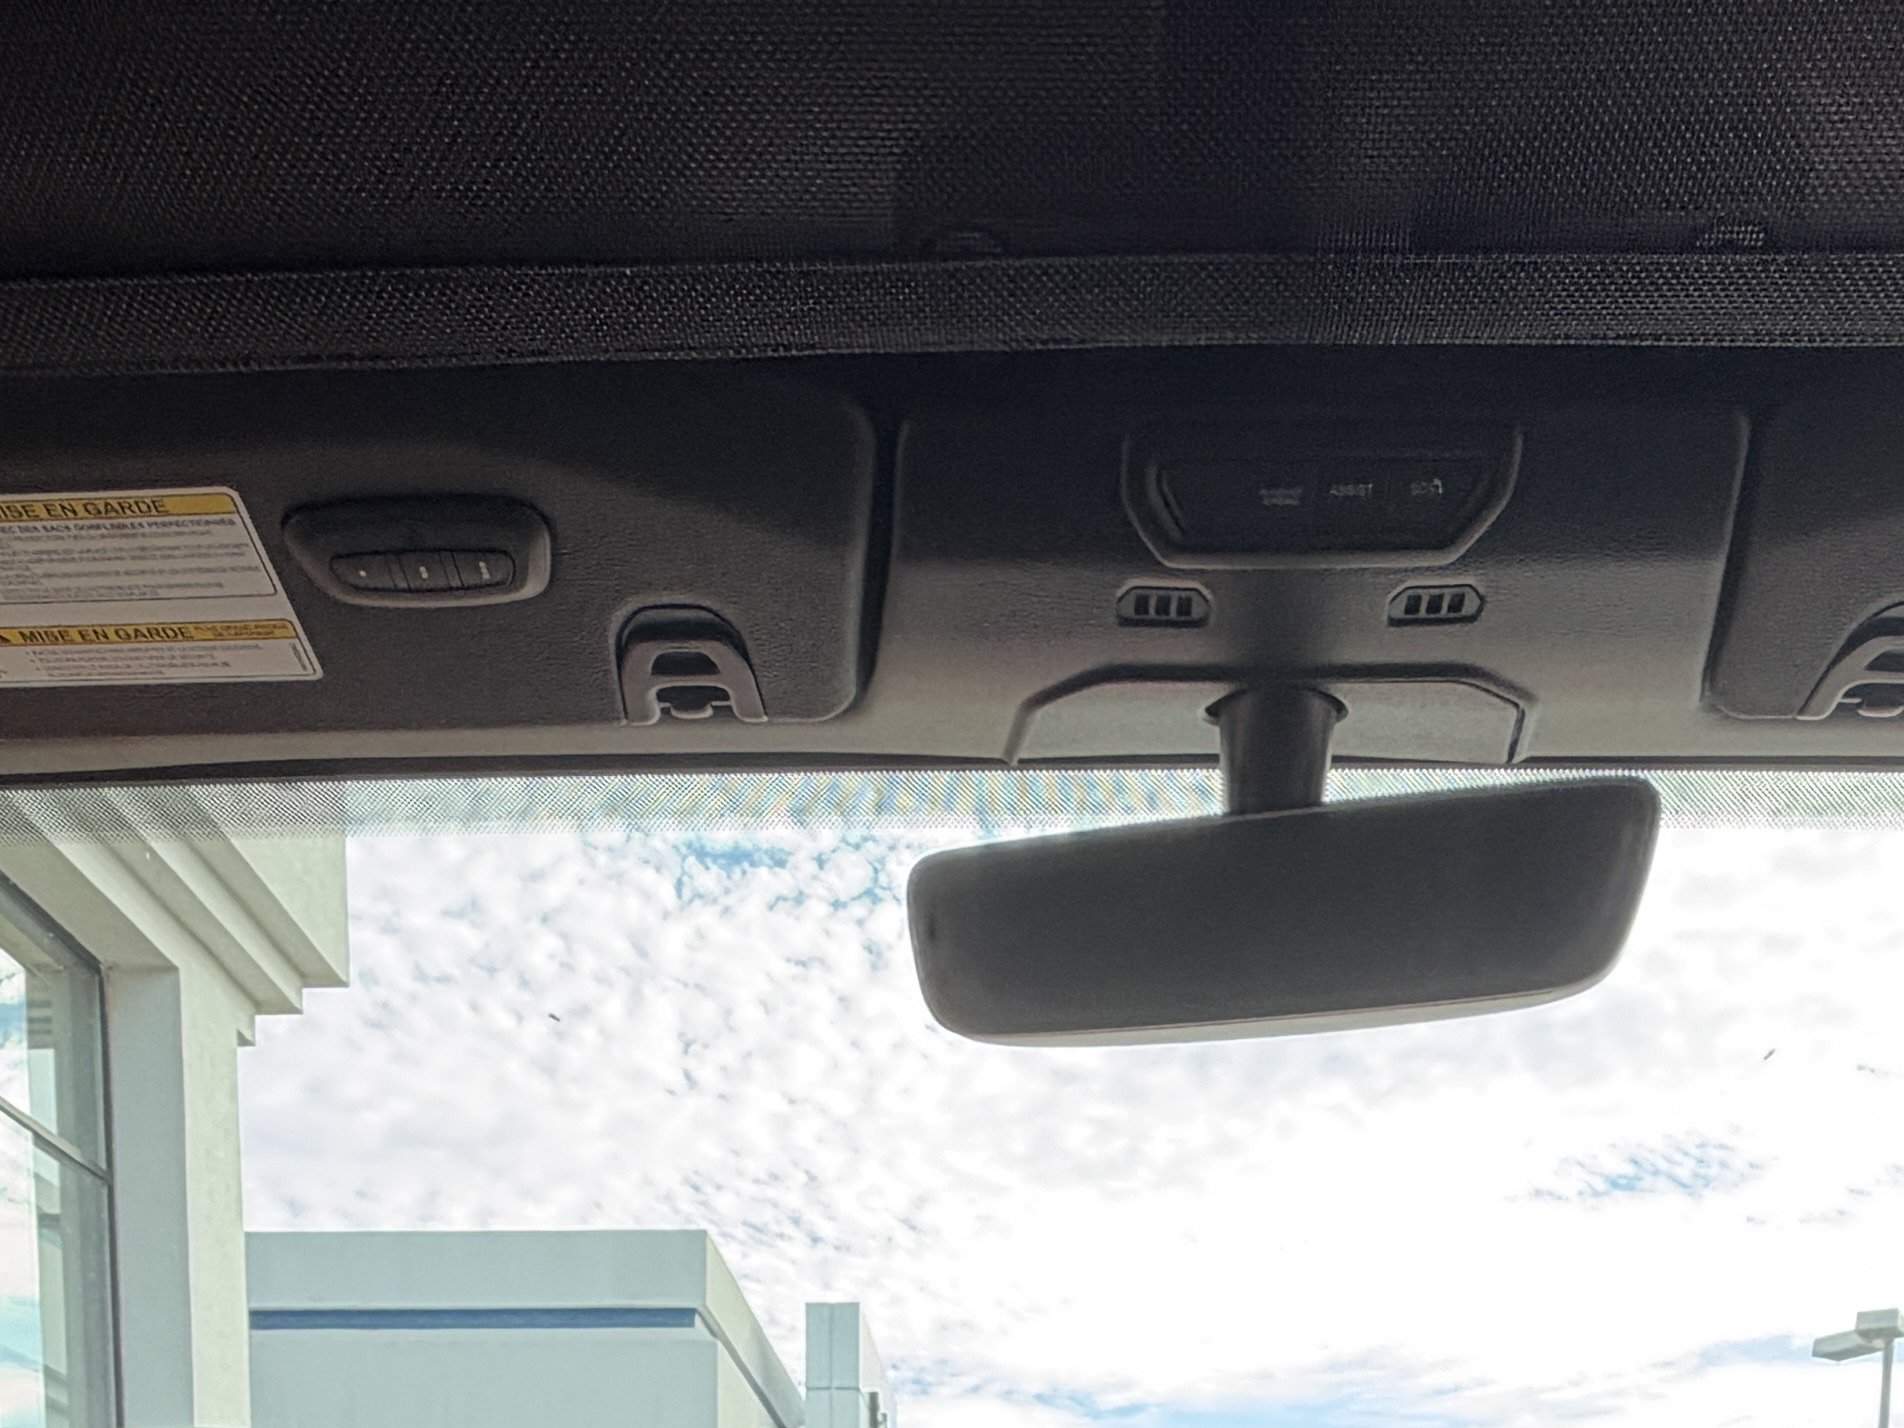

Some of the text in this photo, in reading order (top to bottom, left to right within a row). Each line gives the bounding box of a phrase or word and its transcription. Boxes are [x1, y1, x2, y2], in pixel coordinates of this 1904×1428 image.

[45, 503, 79, 518] EN
[83, 499, 166, 516] GARDE
[19, 629, 71, 643] MISE
[77, 627, 108, 641] EN
[113, 626, 193, 640] GARDE
